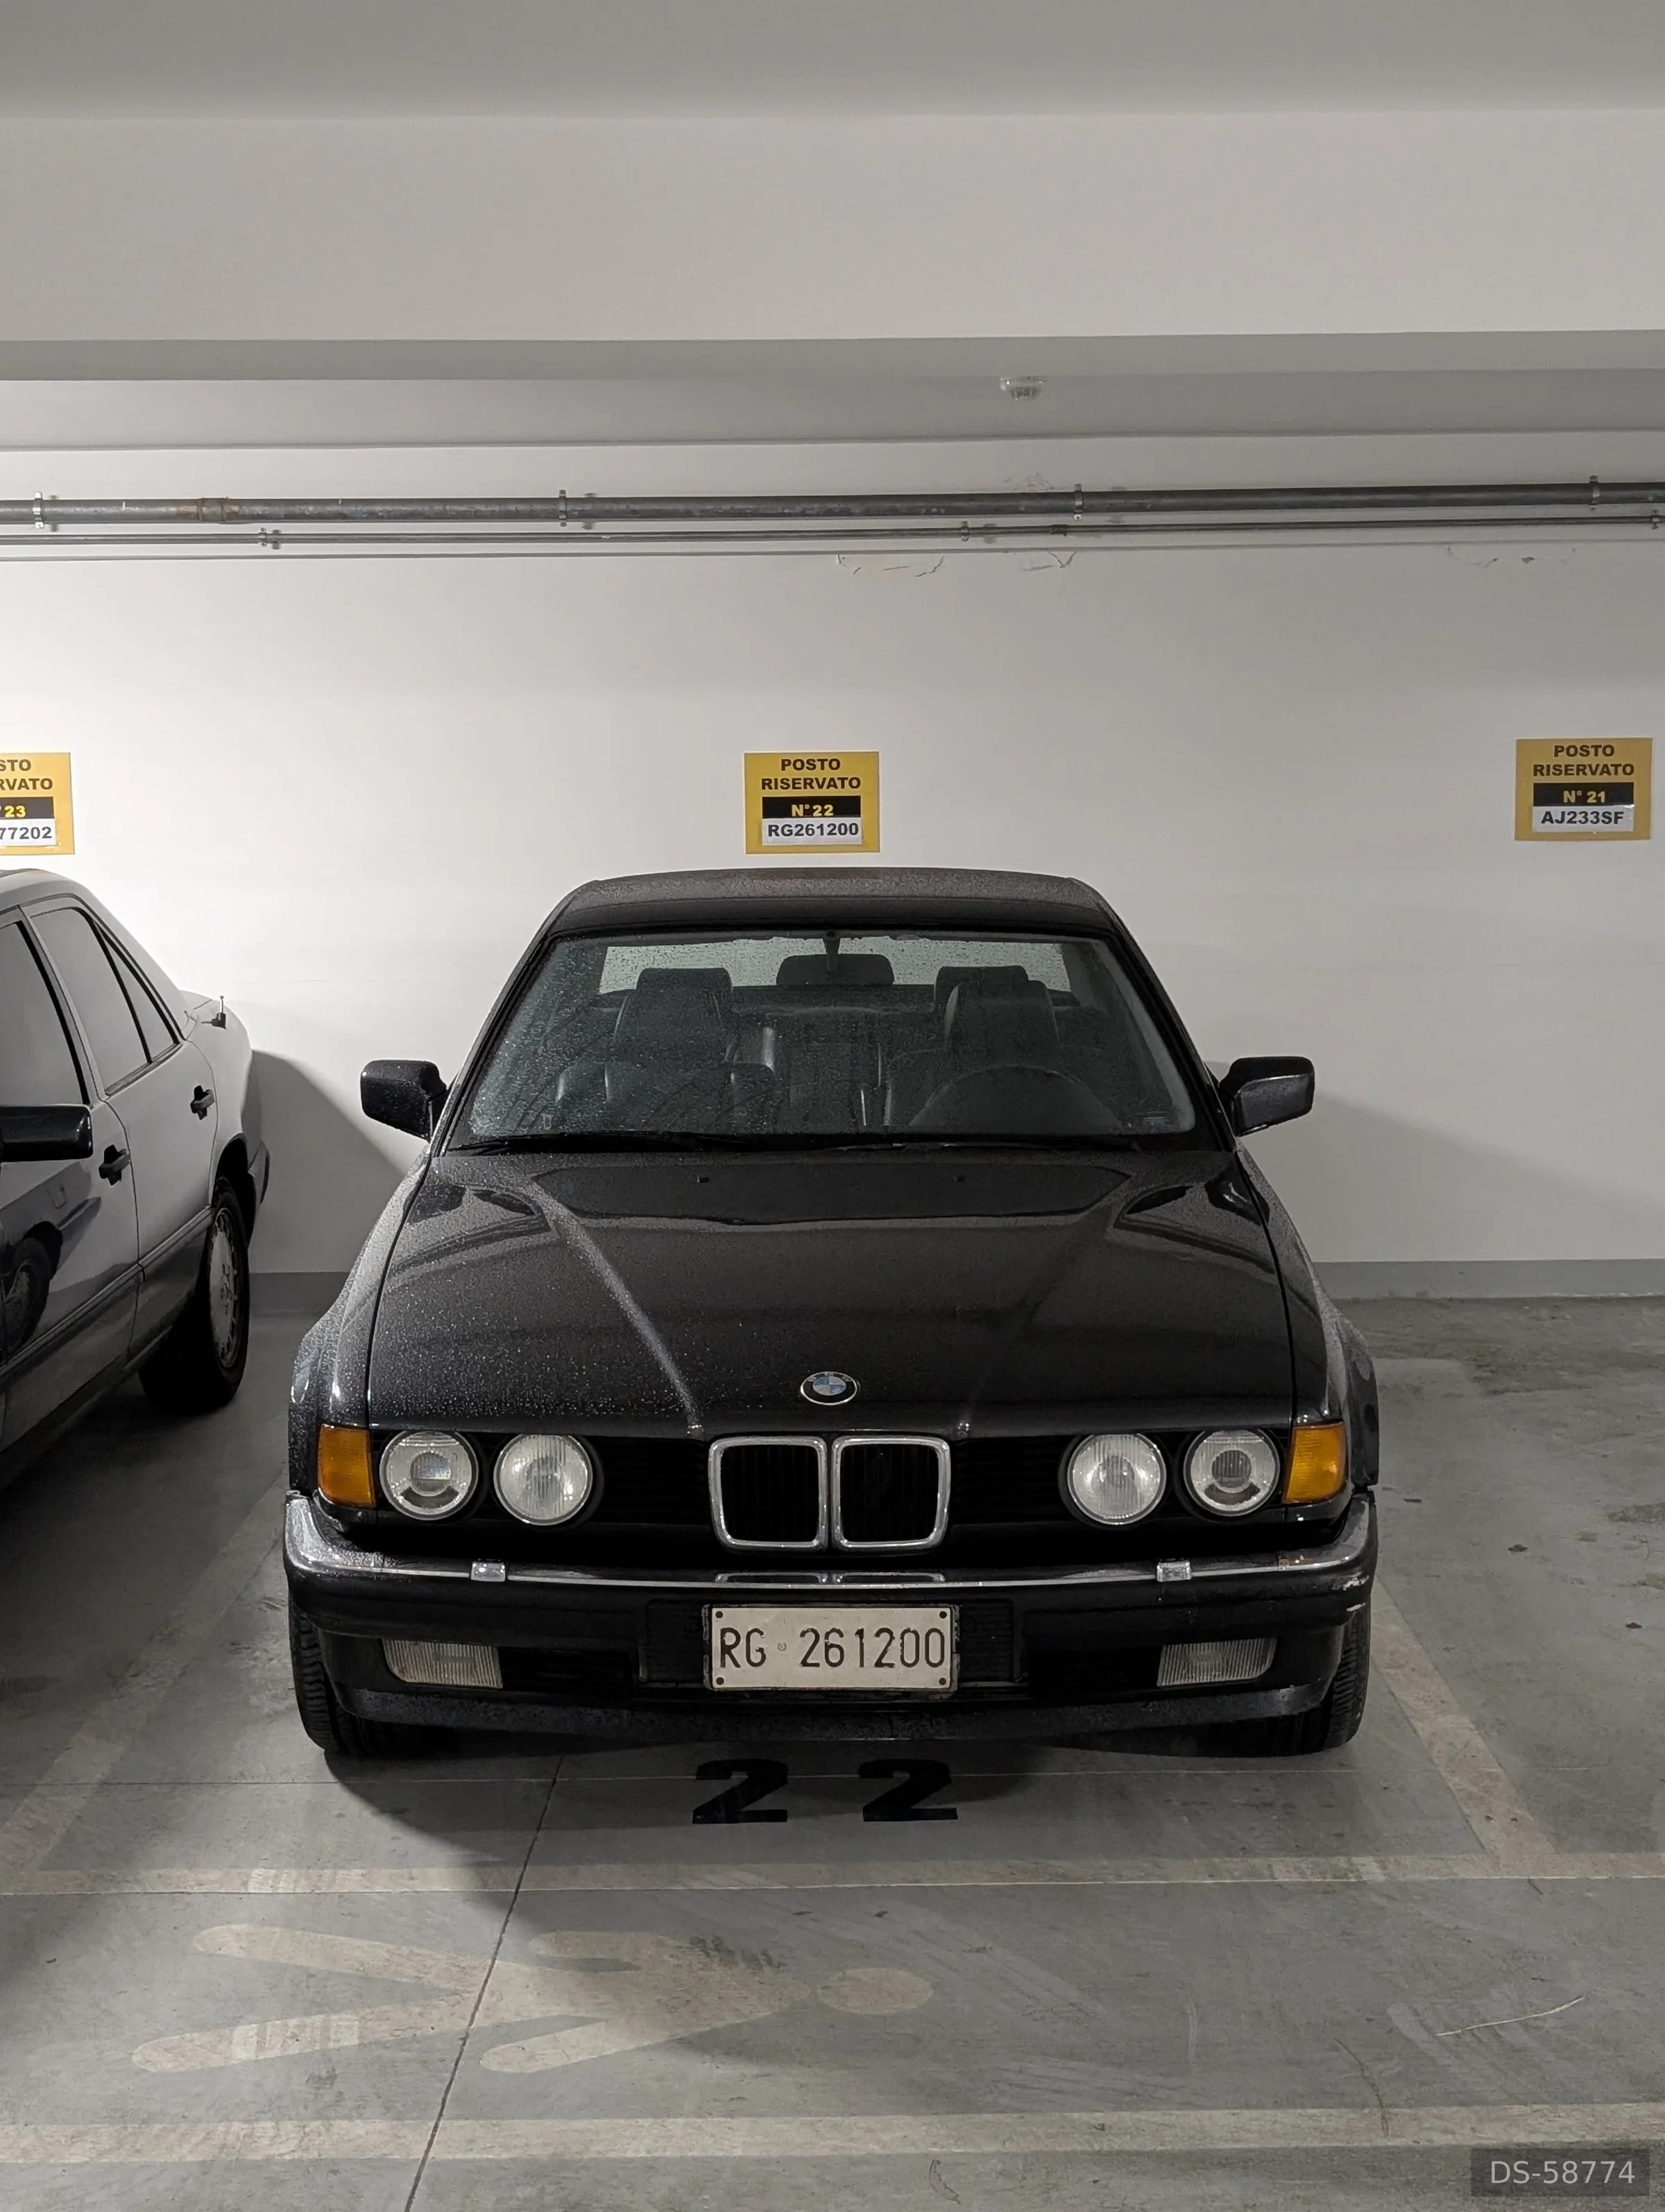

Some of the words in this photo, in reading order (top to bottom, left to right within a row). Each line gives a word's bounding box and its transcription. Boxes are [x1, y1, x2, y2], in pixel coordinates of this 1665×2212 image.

[1553, 745, 1615, 757] POSTO
[780, 758, 841, 771] POSTO
[1532, 764, 1635, 776] RISERVATO
[761, 777, 862, 790] RISERVATO
[1587, 791, 1605, 803] 21
[1541, 811, 1624, 824] AJ233SF
[768, 823, 859, 837] RG261200
[719, 1627, 767, 1668] RG
[799, 1627, 946, 1668] 261200
